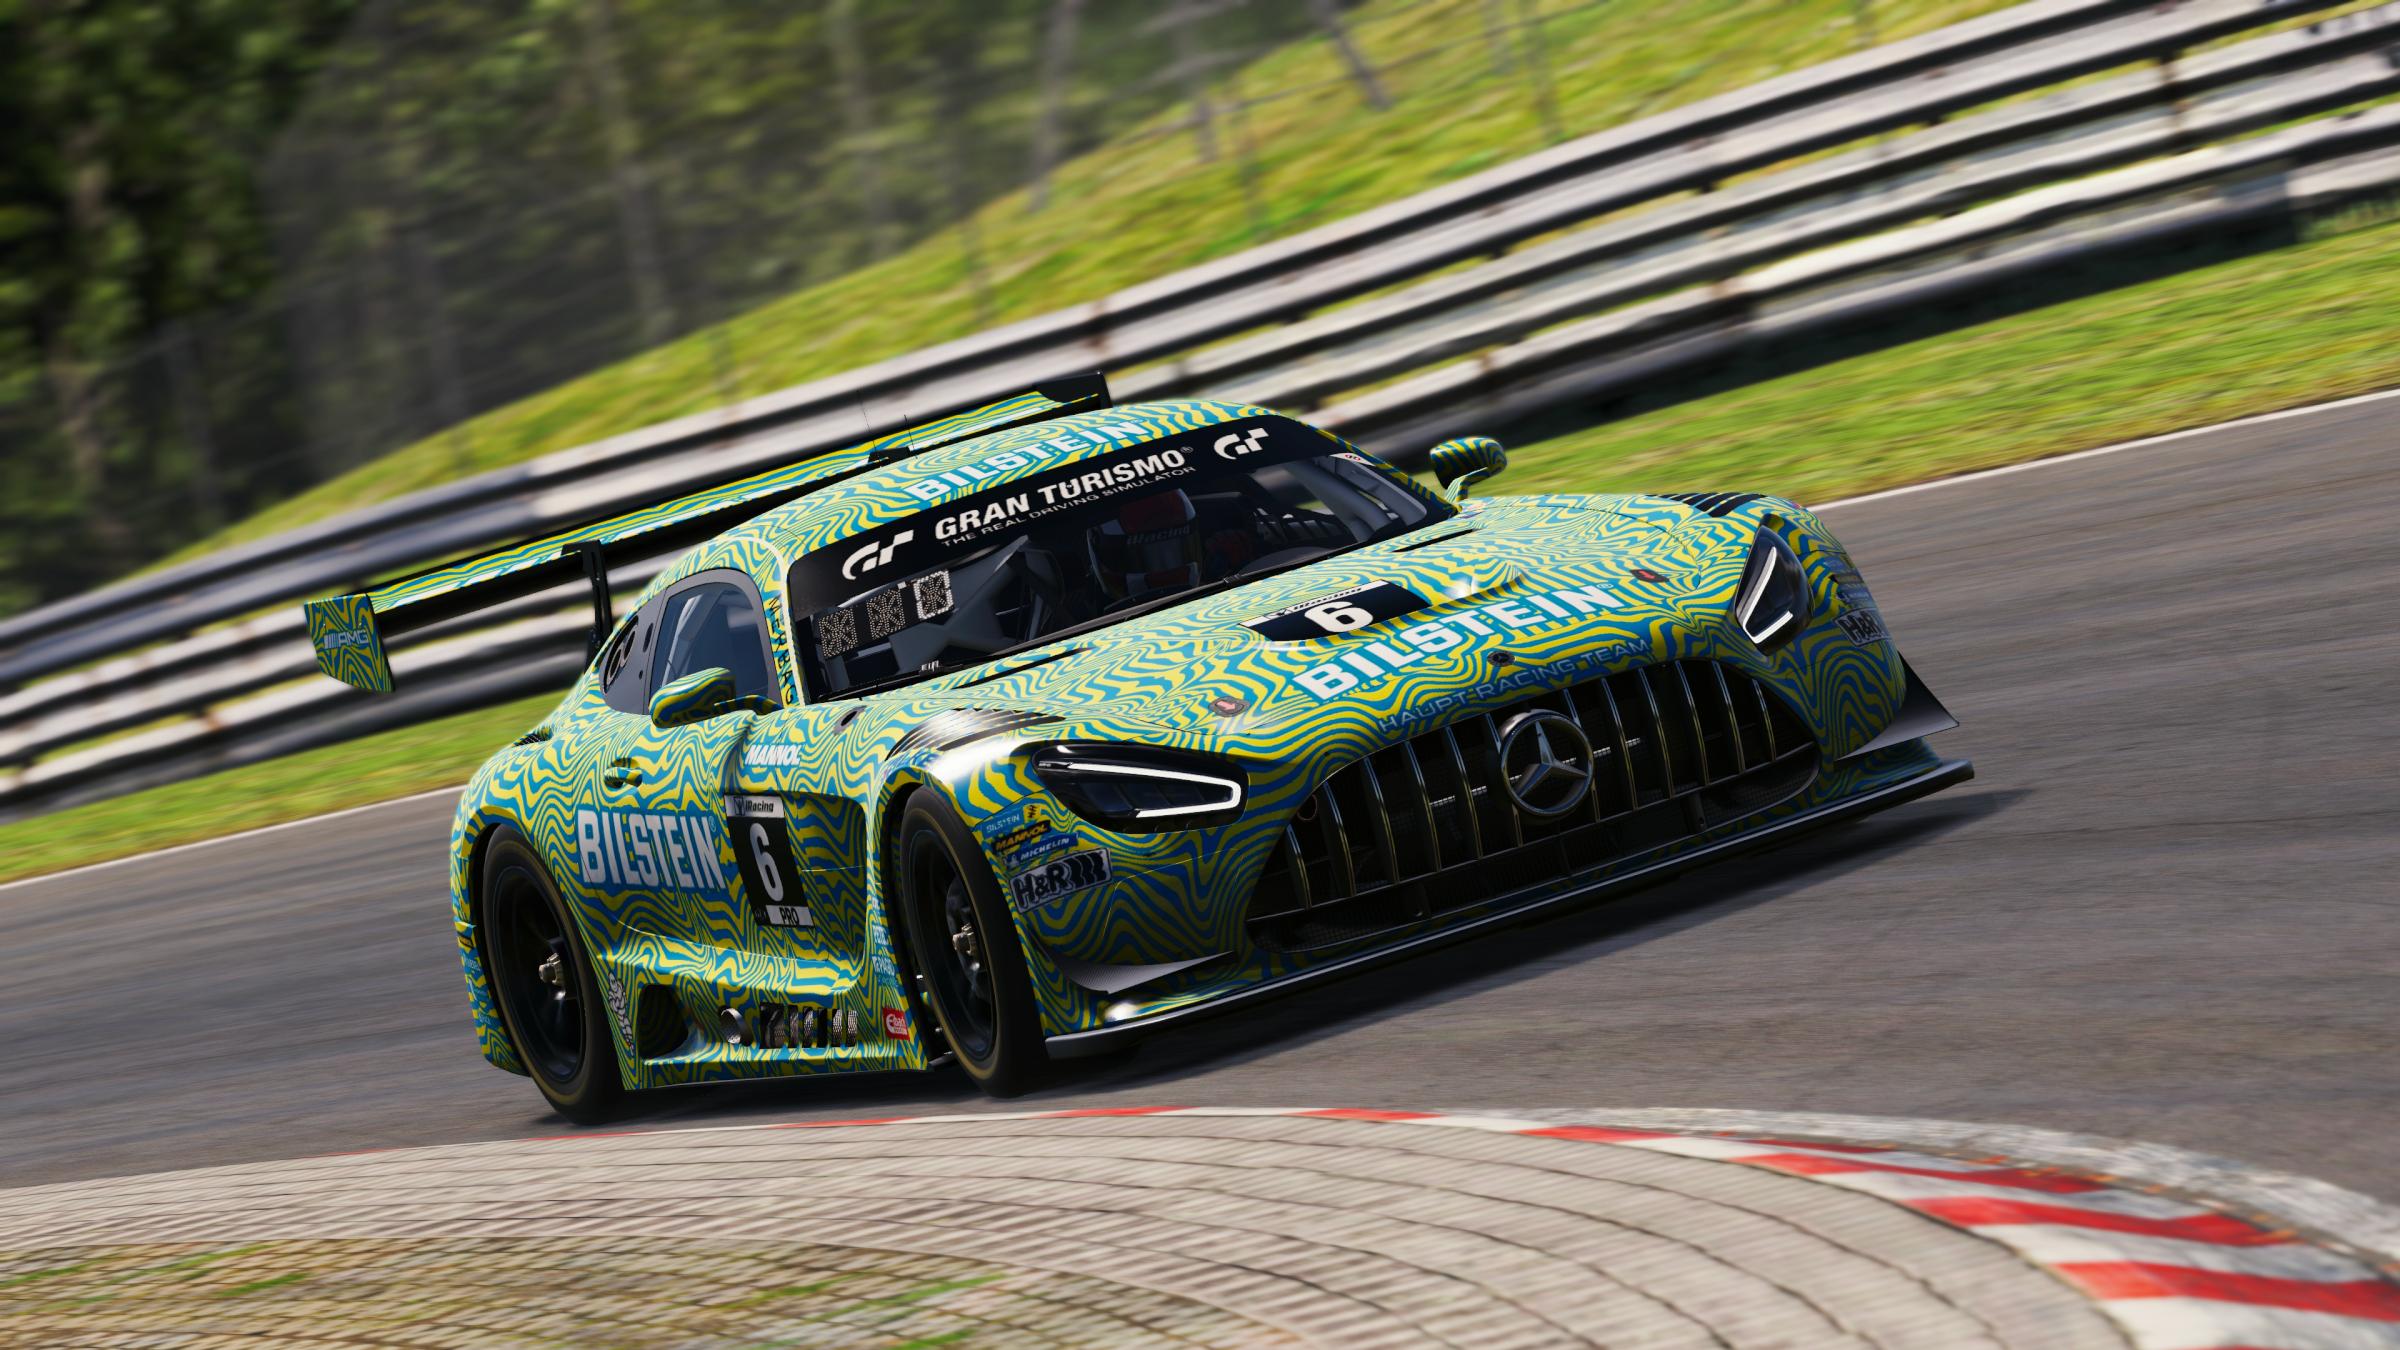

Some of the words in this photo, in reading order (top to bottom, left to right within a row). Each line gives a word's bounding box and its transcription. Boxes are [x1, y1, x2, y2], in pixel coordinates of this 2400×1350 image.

[904, 421, 1151, 502] BILSTEIN
[935, 493, 1031, 540] GRAN
[1037, 449, 1187, 505] TURISMO
[941, 531, 976, 548] THE
[981, 515, 1024, 537] REAL
[1028, 494, 1100, 520] DRIVING
[1103, 466, 1197, 498] SIMULATOR
[338, 628, 370, 648] AMG
[1293, 585, 1625, 702] BILSTEIN
[1304, 601, 1374, 633] 6
[1378, 691, 1468, 733] HAUPT
[1475, 657, 1578, 701] RACING
[1580, 639, 1651, 667] TEAM
[745, 744, 801, 767] MANNOL
[576, 809, 726, 890] BILSTEIN
[750, 822, 784, 902] 6
[995, 824, 1048, 851] MANNOL
[1020, 838, 1070, 861] MICHELIN
[779, 906, 800, 926] PRO
[1014, 862, 1073, 911] H&R
